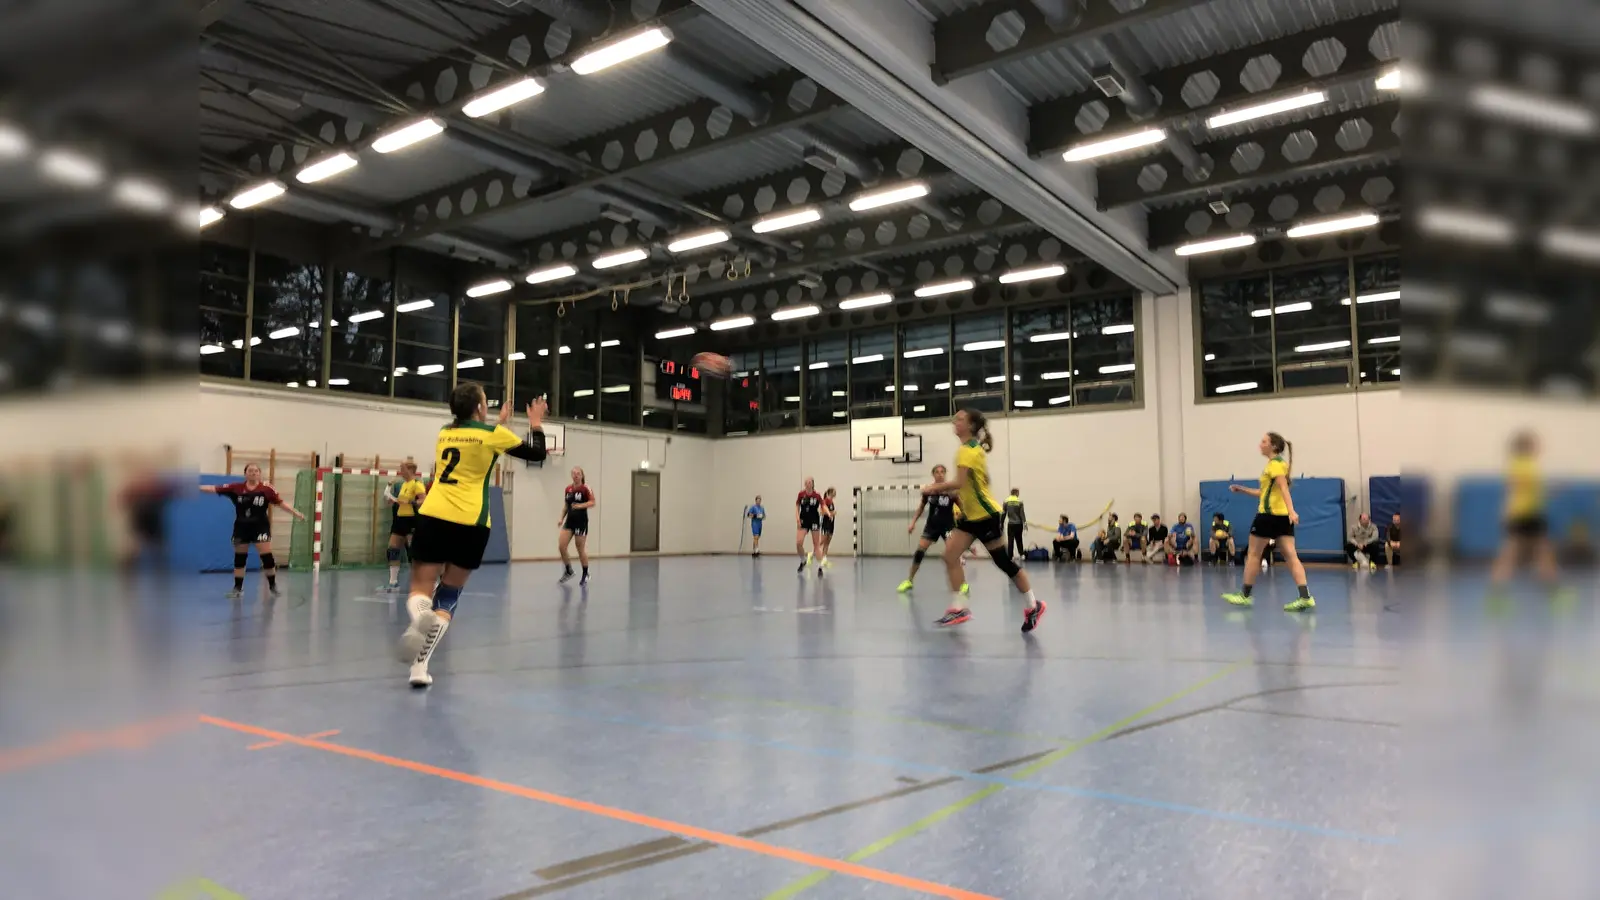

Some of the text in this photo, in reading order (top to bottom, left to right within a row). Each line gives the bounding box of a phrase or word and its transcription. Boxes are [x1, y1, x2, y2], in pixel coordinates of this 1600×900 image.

[439, 447, 461, 484] 2
[253, 495, 265, 507] 46
[257, 533, 268, 542] 46
